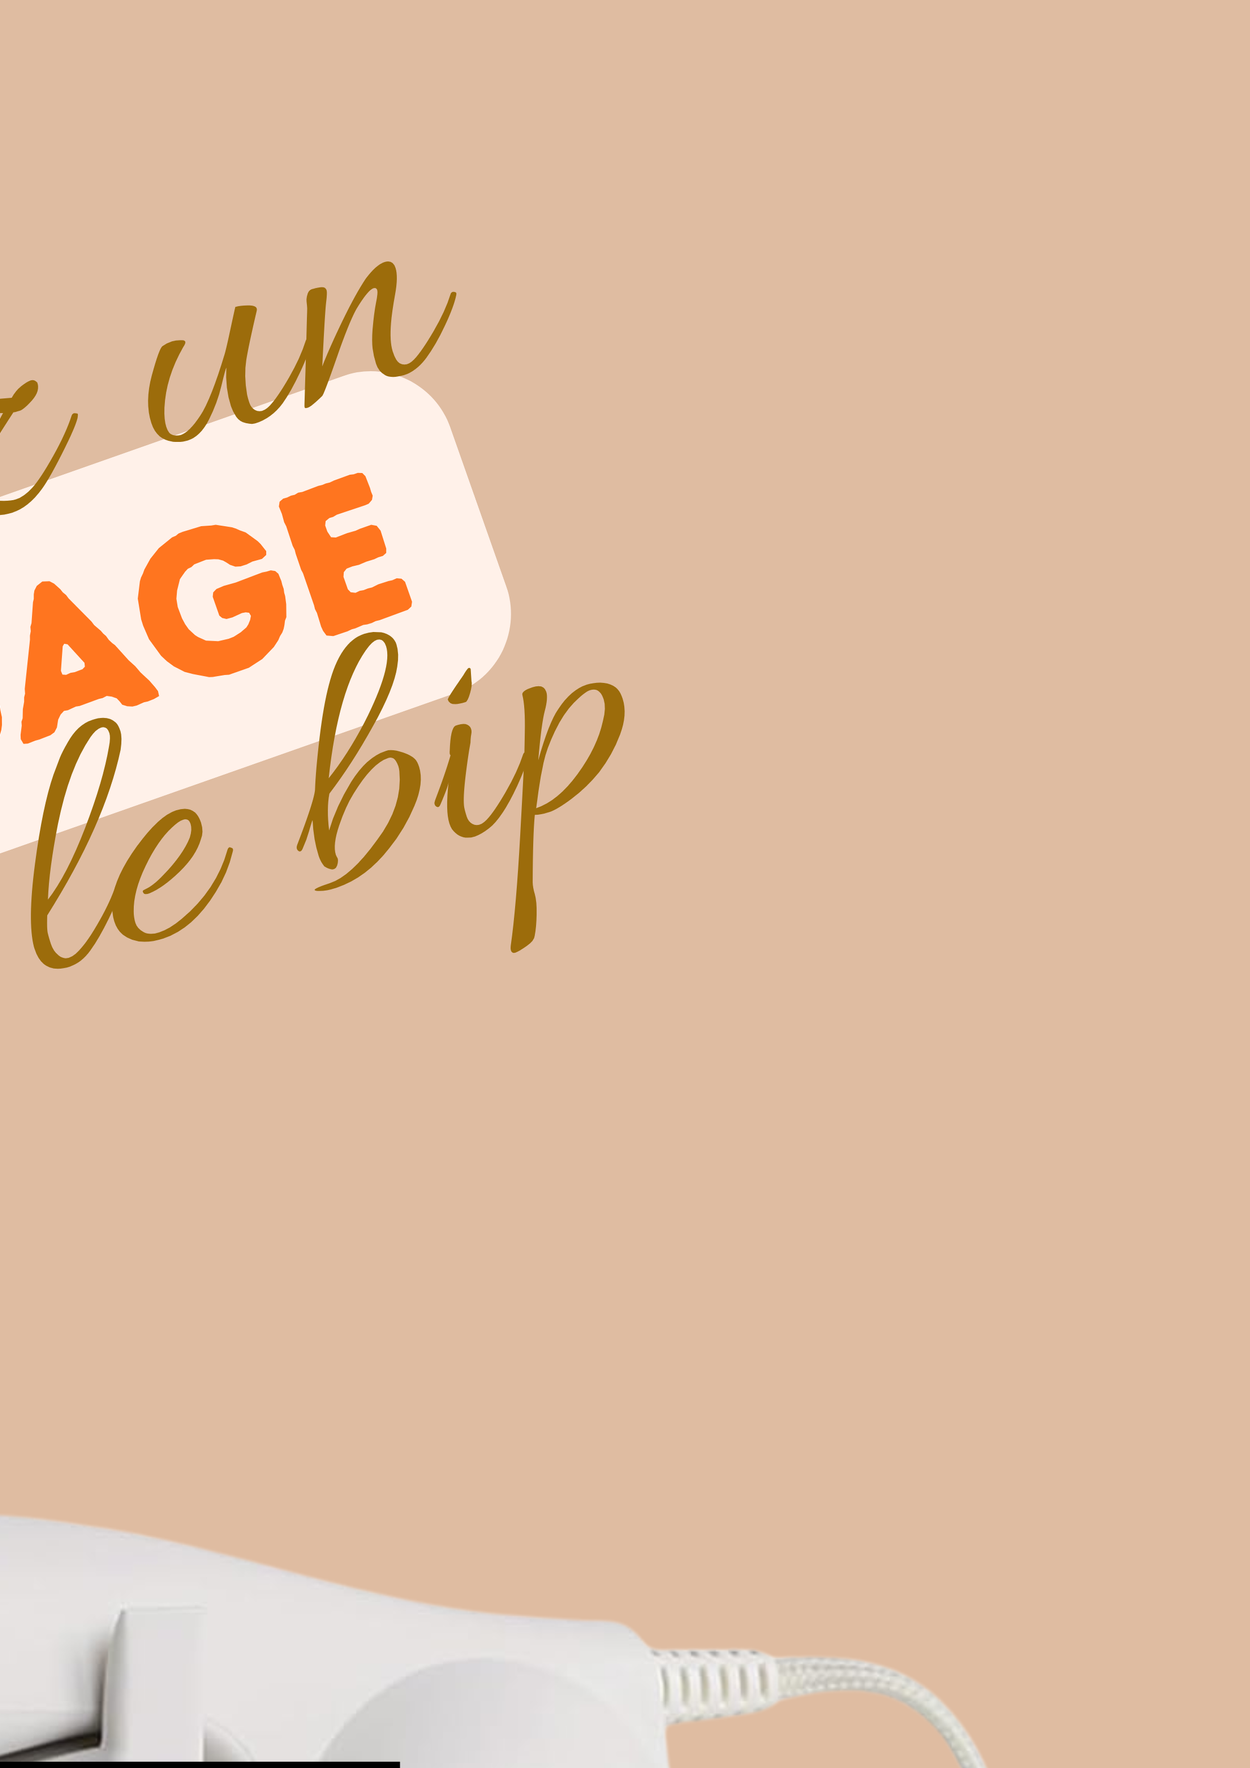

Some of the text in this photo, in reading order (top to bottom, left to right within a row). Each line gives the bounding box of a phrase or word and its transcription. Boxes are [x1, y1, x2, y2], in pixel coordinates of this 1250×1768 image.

[148, 262, 456, 442] un
[31, 718, 233, 968] le
[297, 632, 624, 953] bip
